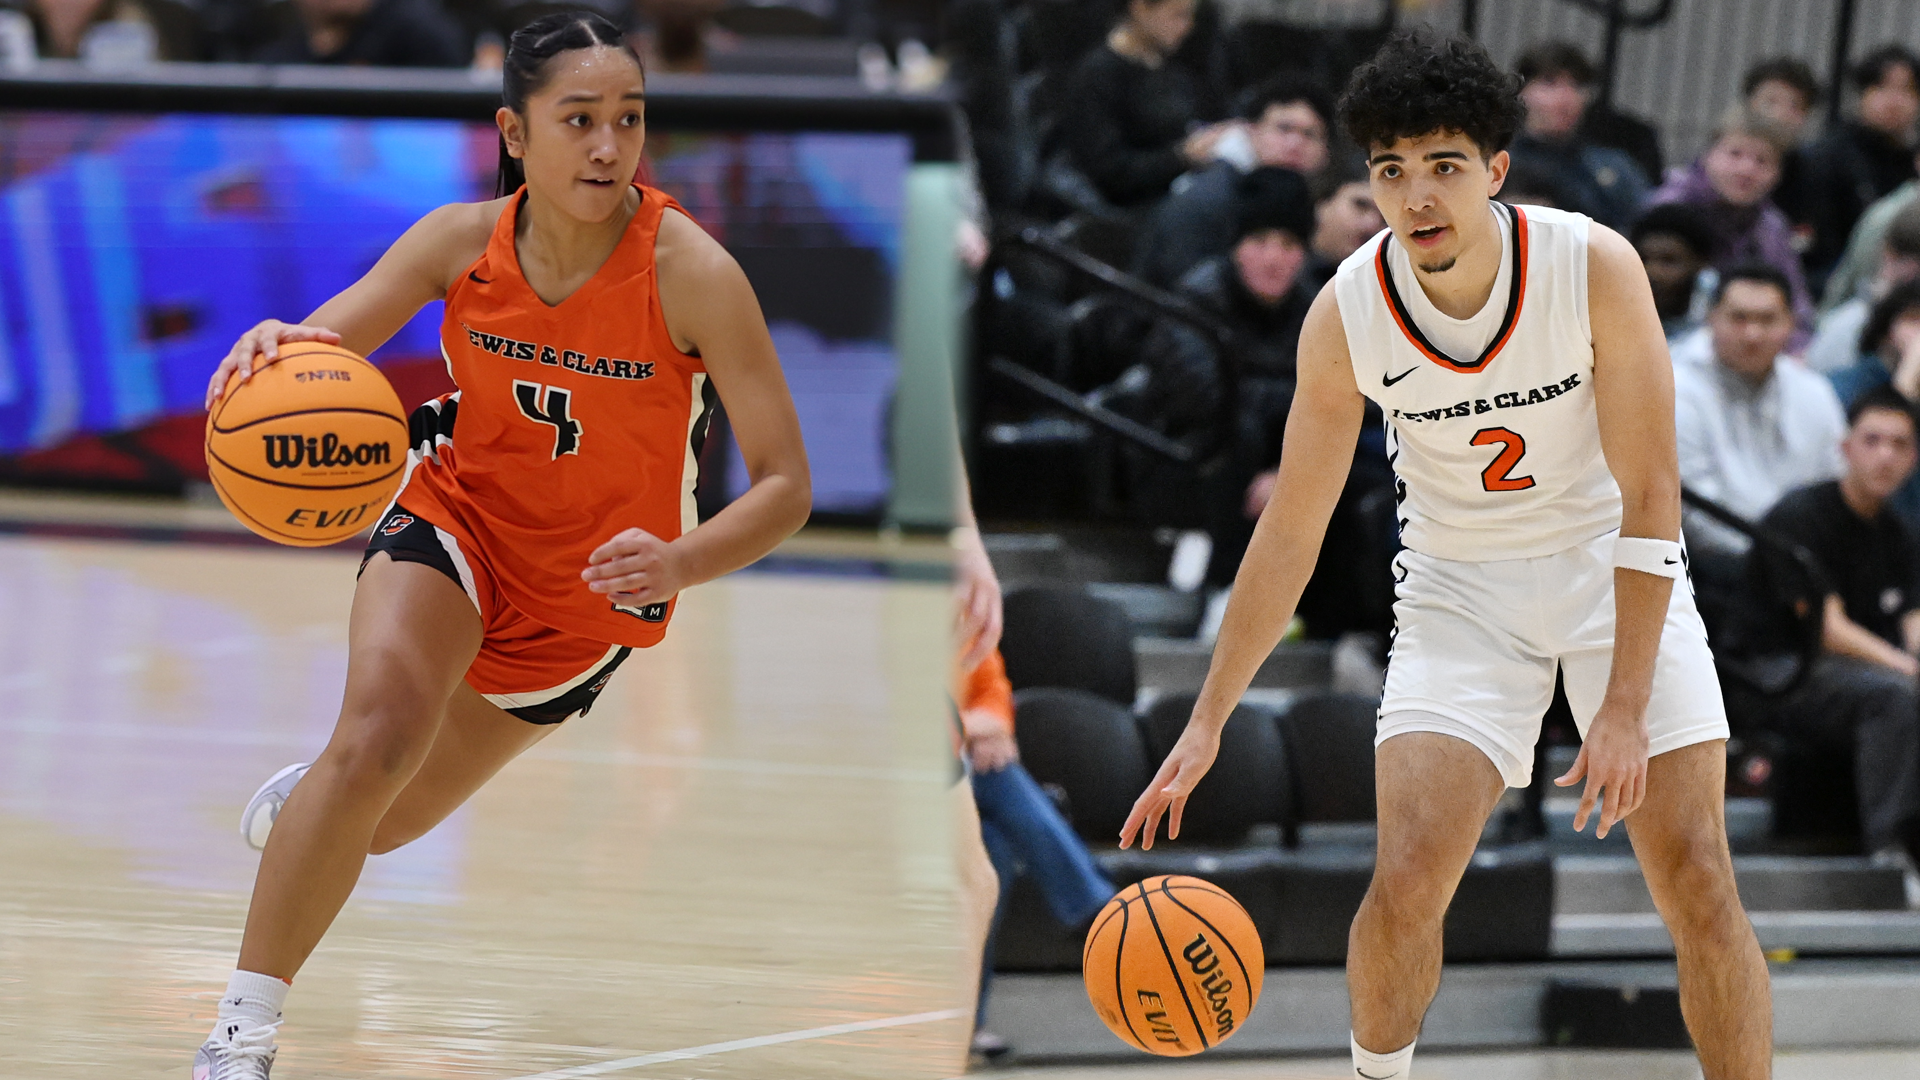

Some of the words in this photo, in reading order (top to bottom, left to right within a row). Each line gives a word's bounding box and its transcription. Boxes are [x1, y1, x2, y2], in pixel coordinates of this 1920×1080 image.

[460, 322, 537, 361] EWIS
[539, 345, 559, 366] &
[561, 349, 655, 380] CLARK
[512, 379, 584, 461] 4
[1474, 399, 1492, 415] &
[1493, 372, 1582, 409] CLARK
[262, 433, 391, 469] Wilson
[1469, 426, 1537, 492] 2
[650, 606, 661, 617] M
[1183, 932, 1234, 1042] Wilson
